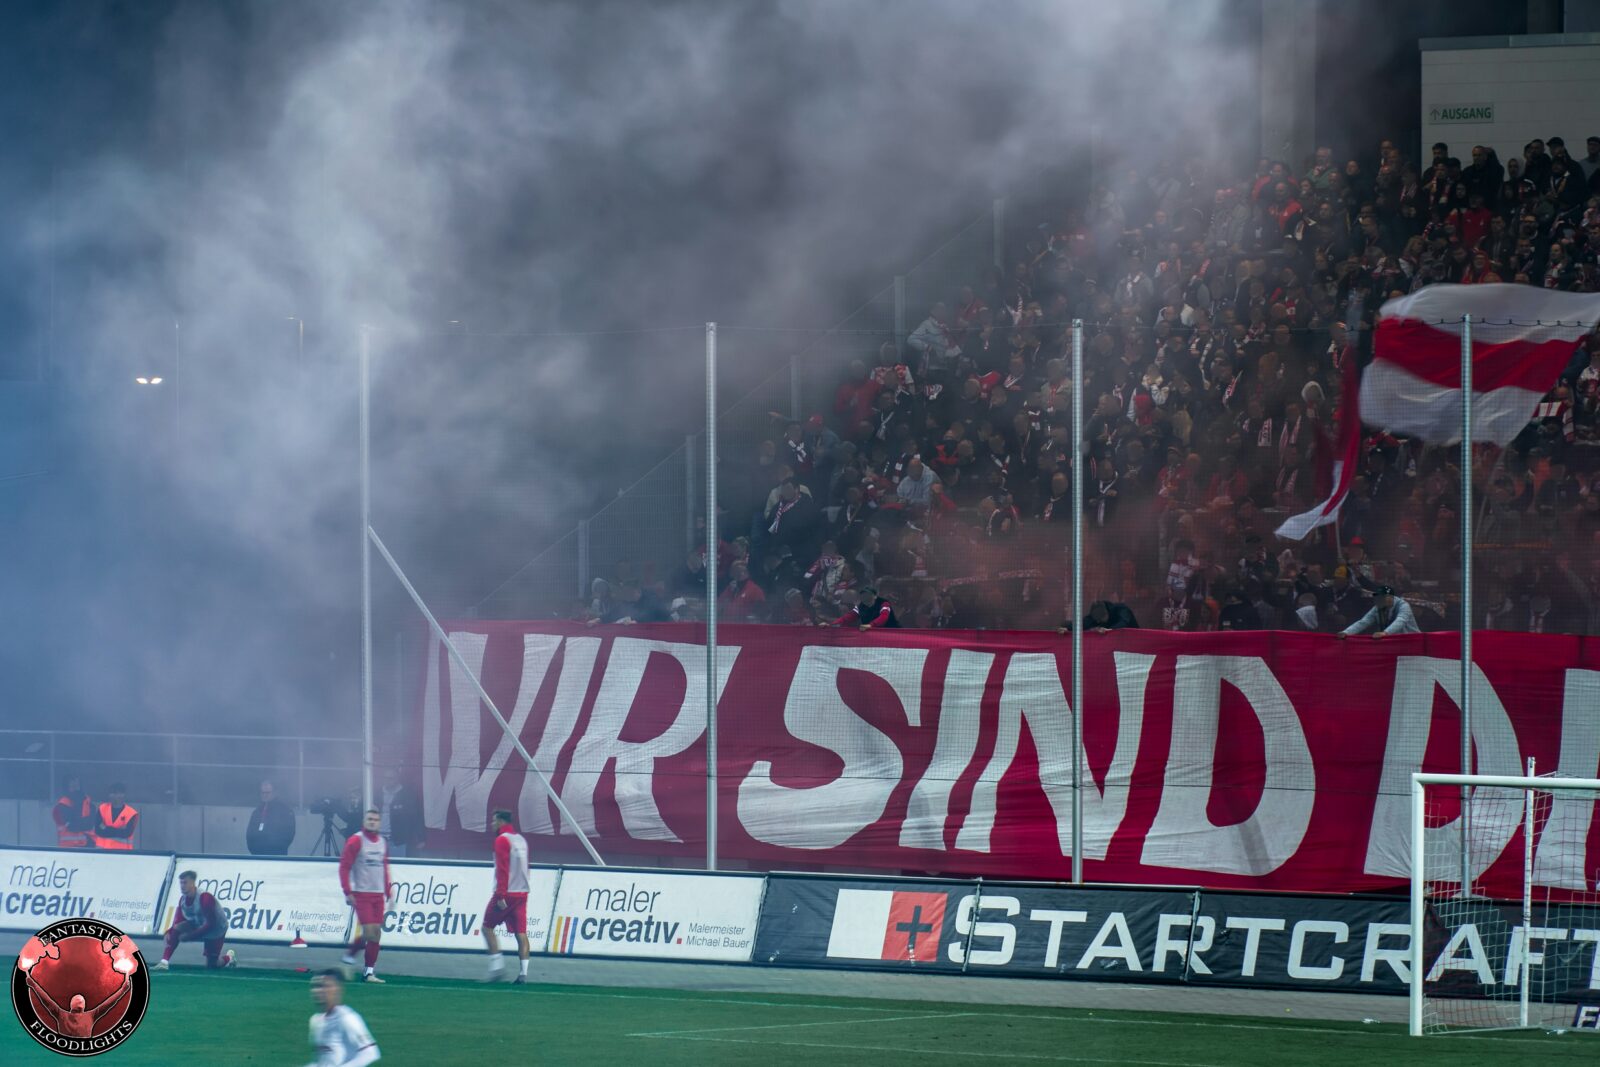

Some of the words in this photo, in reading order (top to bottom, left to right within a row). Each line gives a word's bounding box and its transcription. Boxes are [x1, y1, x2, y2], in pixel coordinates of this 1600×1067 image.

[1441, 107, 1492, 120] AUSGANG
[422, 630, 742, 843] WIR
[737, 644, 1316, 877] SIND
[1364, 655, 1600, 891] DI
[10, 860, 79, 889] maler
[386, 875, 459, 905] maler
[5, 891, 95, 918] creativ.
[100, 898, 152, 910] Malermeister
[585, 883, 661, 913] maler
[98, 910, 128, 921] Michael
[130, 912, 154, 922] Bauer
[223, 904, 284, 931] ativ.
[289, 910, 344, 921] Malermeister
[320, 923, 345, 933] Bauer
[527, 930, 544, 939] auer
[580, 915, 683, 944] creativ.
[688, 923, 745, 935] Malermeister
[686, 935, 721, 947] Michael
[722, 937, 750, 948] Bauer
